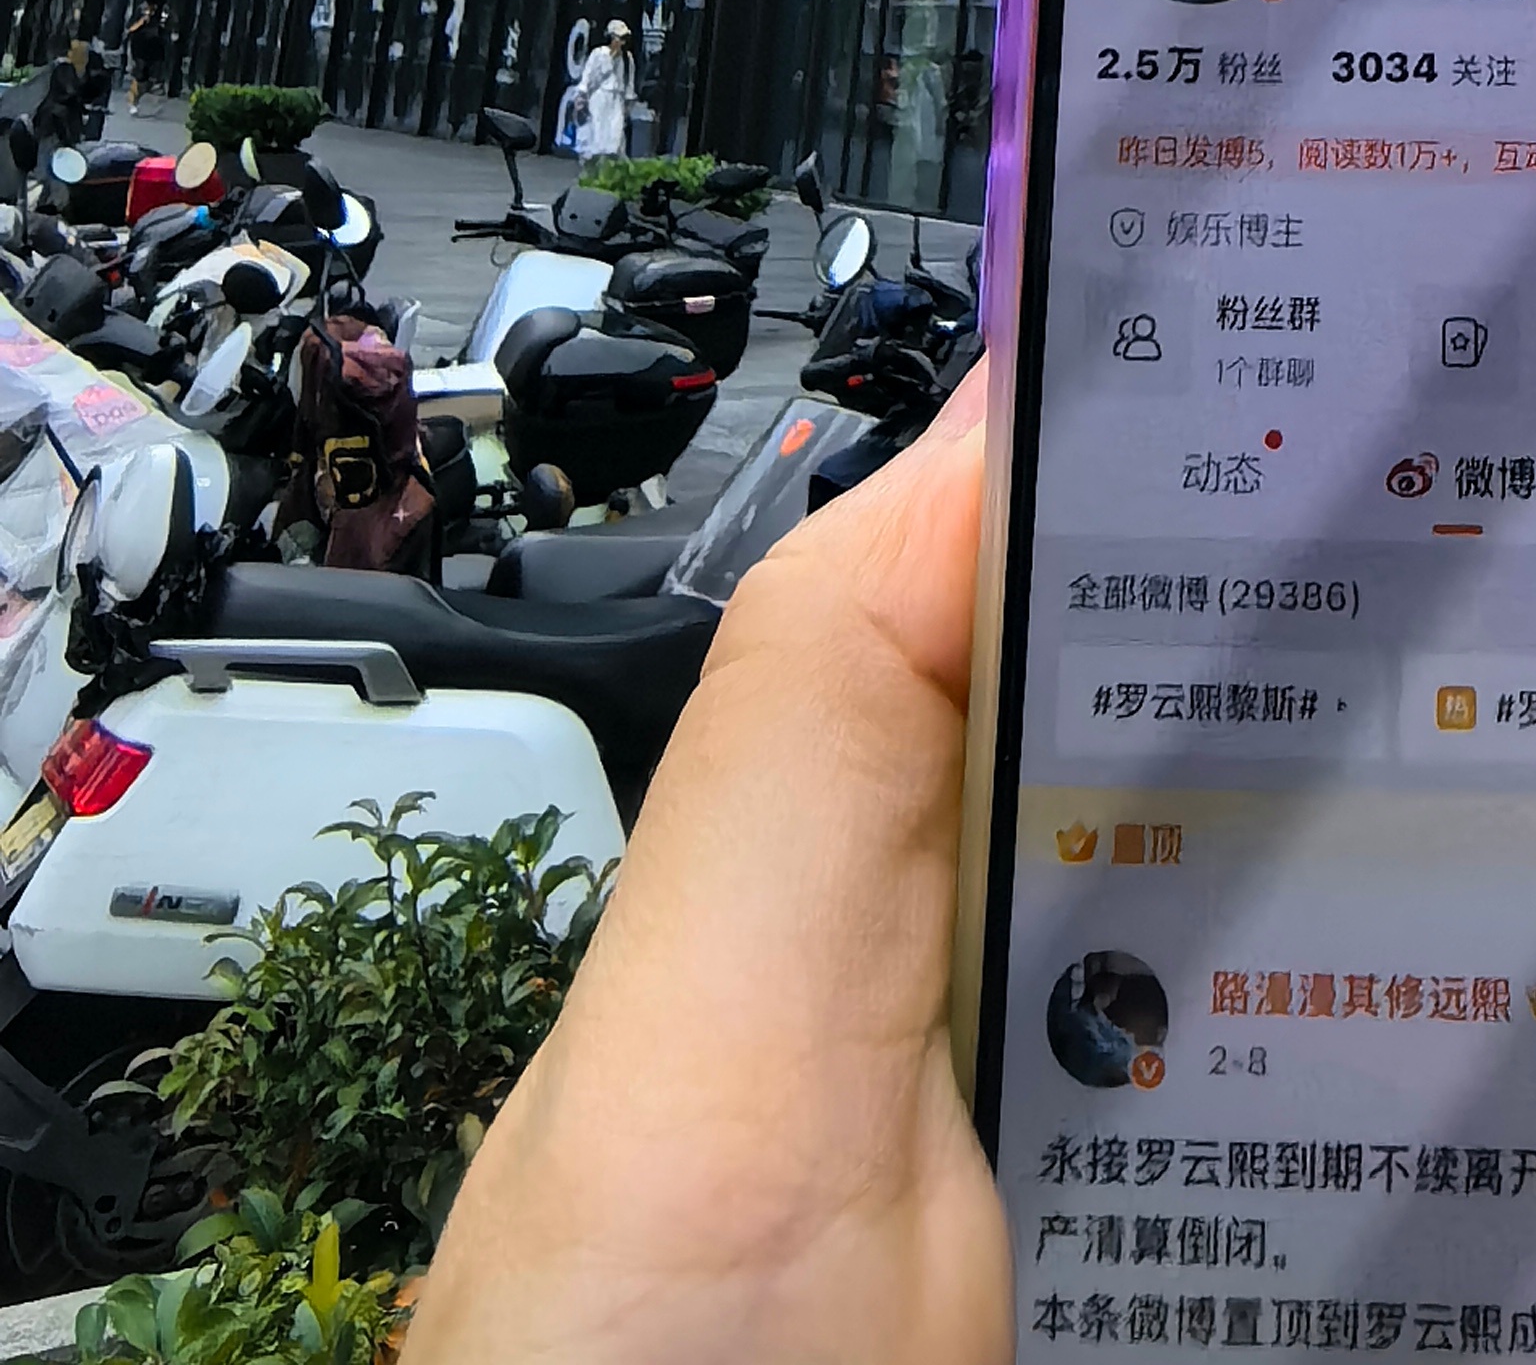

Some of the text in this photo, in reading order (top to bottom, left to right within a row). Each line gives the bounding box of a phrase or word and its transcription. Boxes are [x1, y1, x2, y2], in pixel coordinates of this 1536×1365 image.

[1097, 46, 1203, 85] 2.5万
[1218, 52, 1283, 86] 粉丝
[1331, 52, 1438, 85] 3034
[1451, 54, 1517, 88] 关注
[1166, 210, 1305, 250] 娱乐博主
[1215, 294, 1322, 333] 粉丝群
[1216, 357, 1316, 390] 1个群聊
[1181, 450, 1264, 496] 动态
[1453, 456, 1536, 501] 微博
[1208, 1045, 1268, 1078] 2-8
